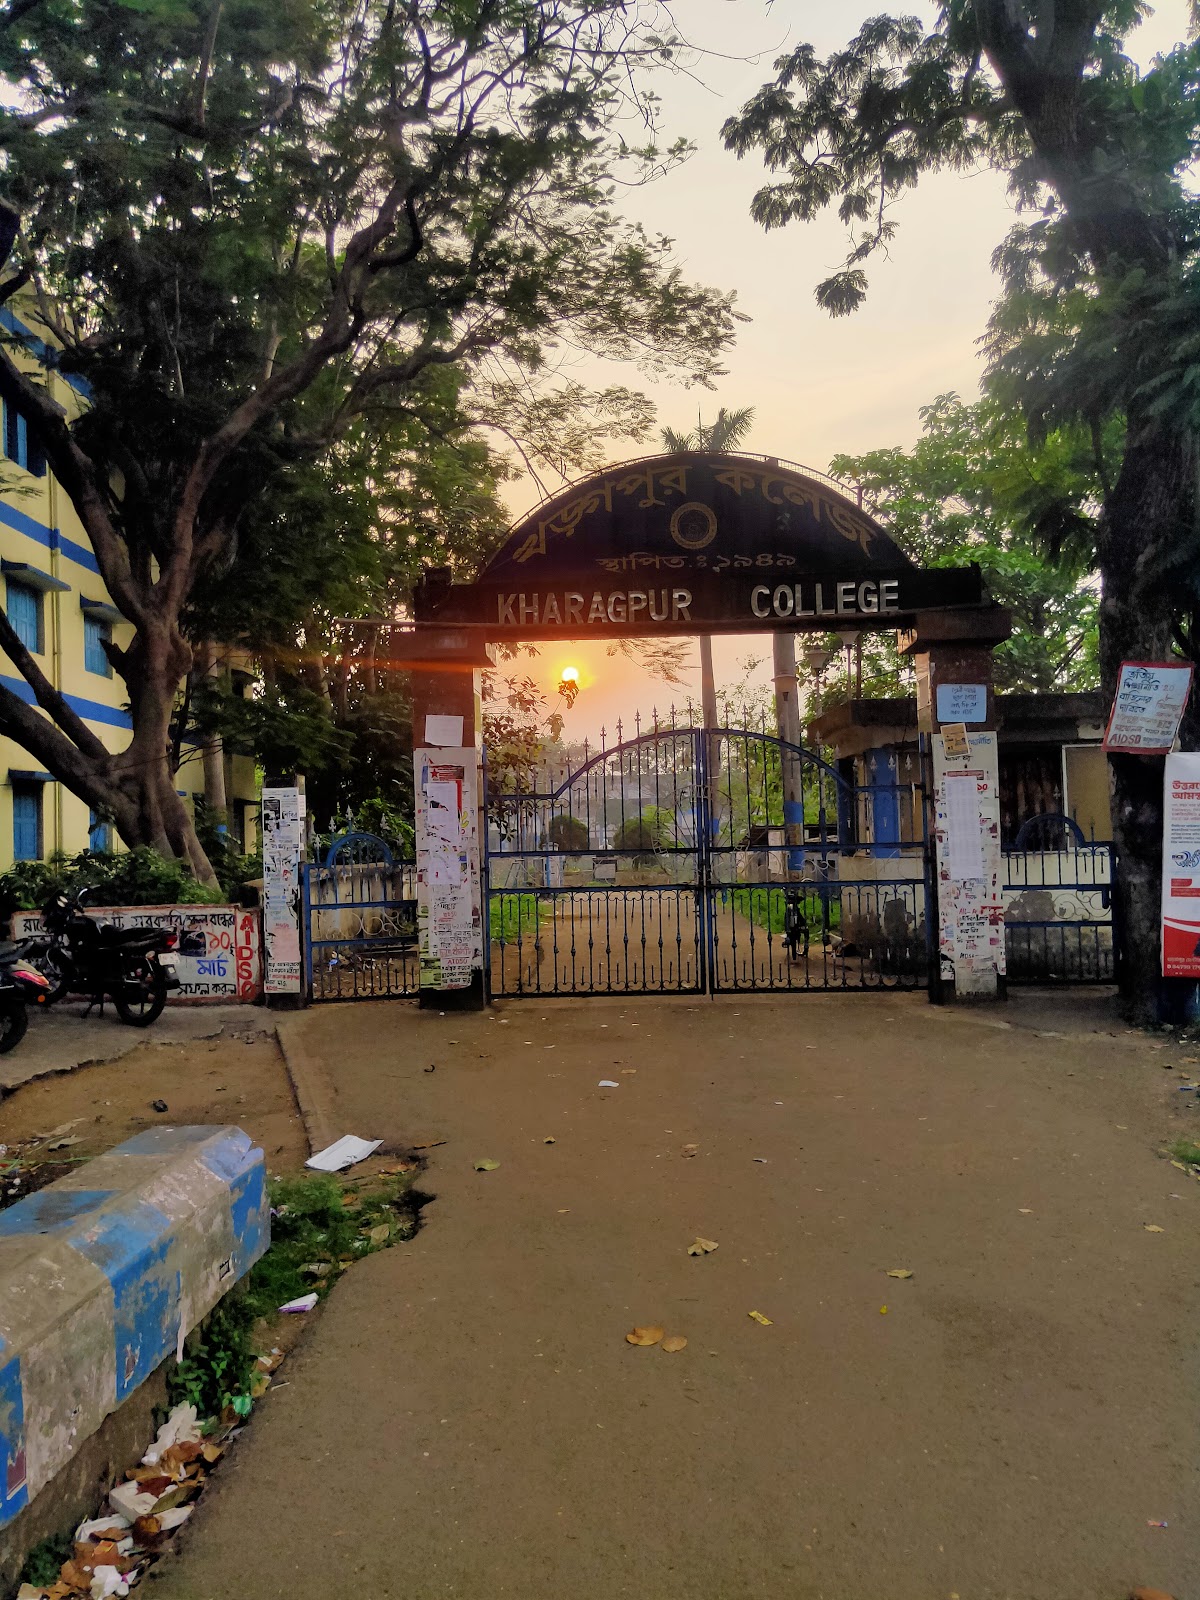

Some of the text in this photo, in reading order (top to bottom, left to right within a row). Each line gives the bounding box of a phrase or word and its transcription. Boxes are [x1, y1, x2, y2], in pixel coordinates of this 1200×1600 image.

[708, 463, 878, 560] কলেজ
[497, 579, 899, 625] KHARAGPUR COLLEGE
[196, 952, 229, 977] মার্চ
